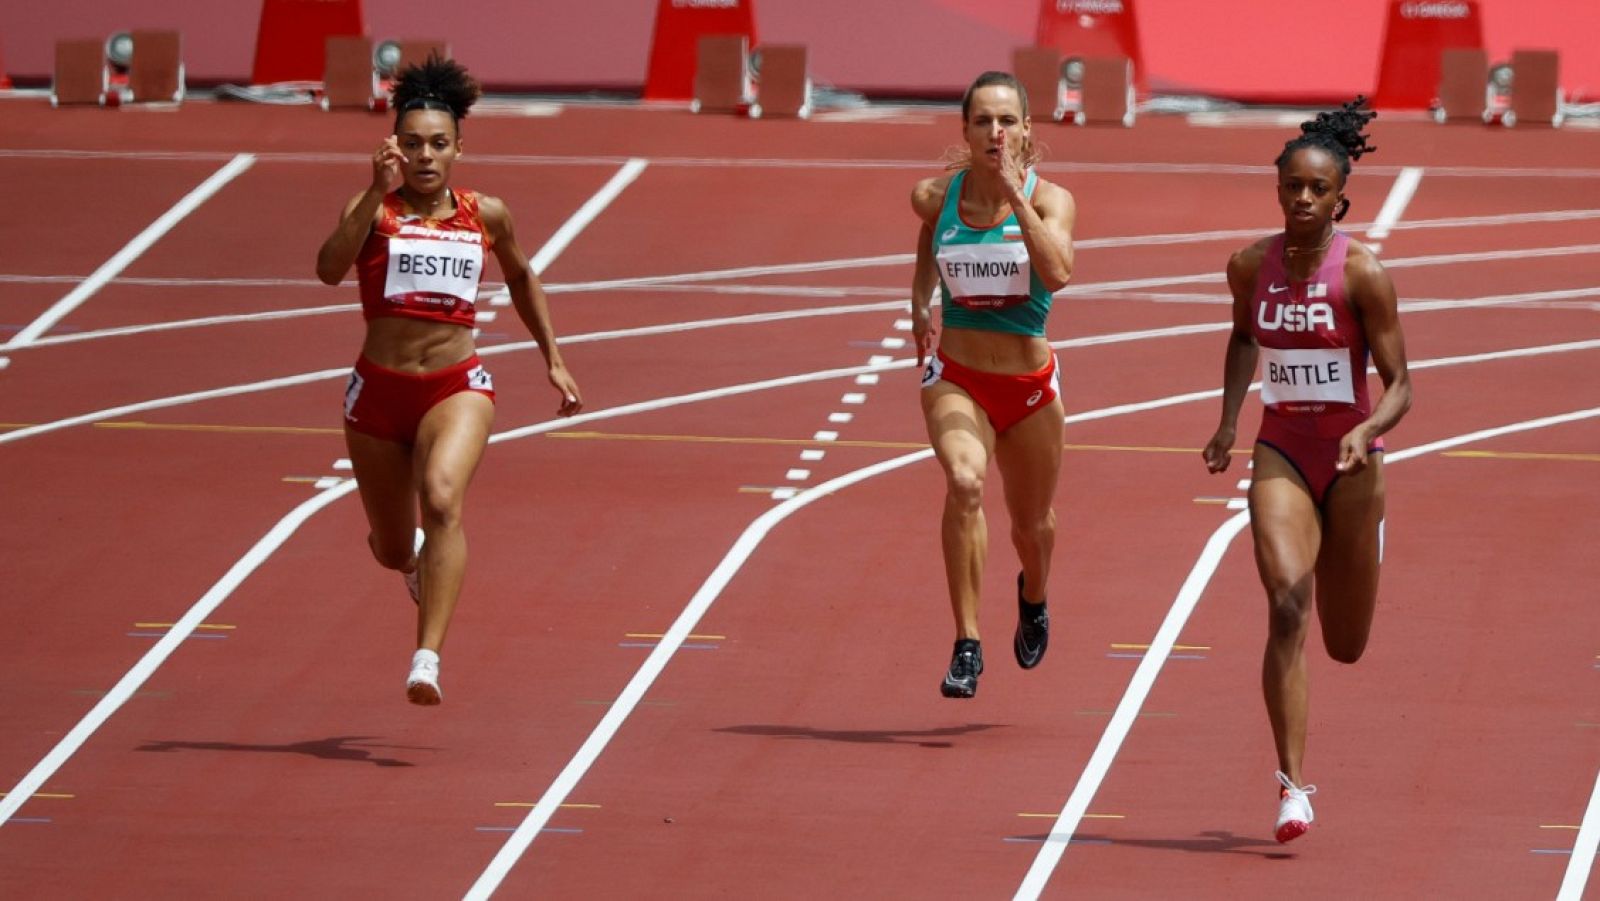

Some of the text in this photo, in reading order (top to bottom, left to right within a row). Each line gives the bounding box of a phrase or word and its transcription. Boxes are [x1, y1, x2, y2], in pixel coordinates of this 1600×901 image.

[399, 253, 475, 279] BESTUE
[946, 261, 1020, 278] EFTIMOVA
[1257, 300, 1336, 332] USA
[1269, 361, 1341, 385] BATTLE
